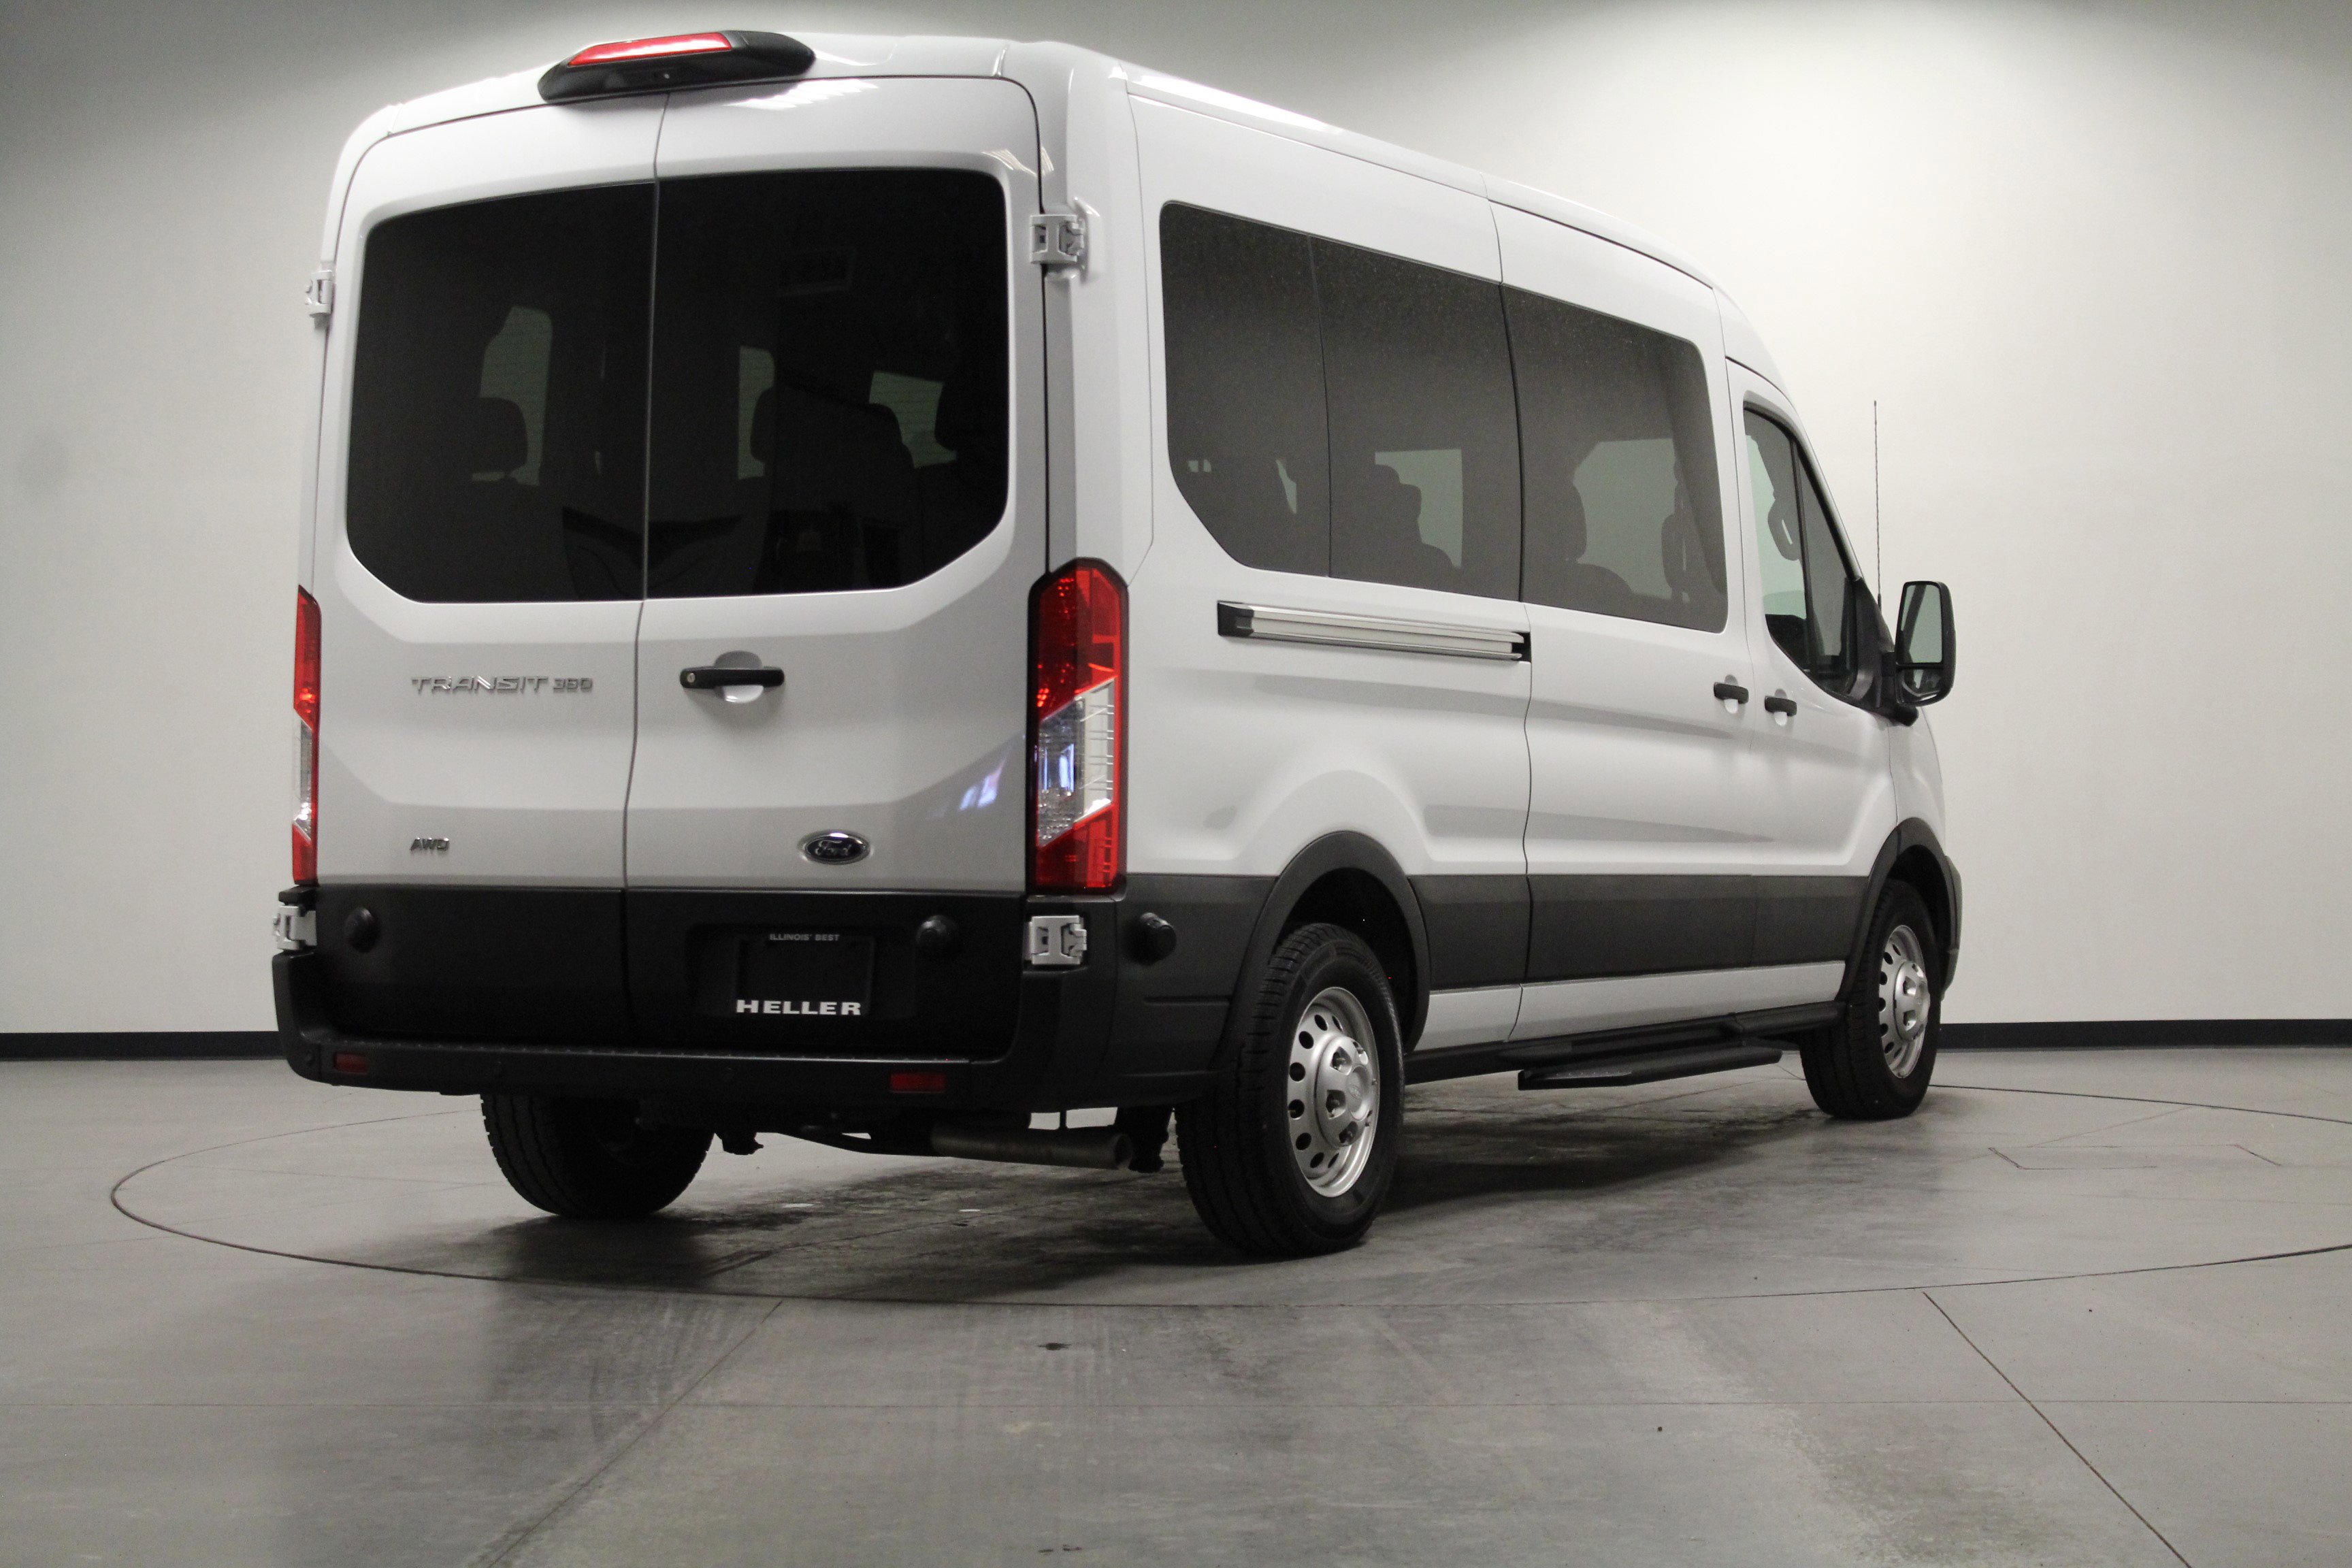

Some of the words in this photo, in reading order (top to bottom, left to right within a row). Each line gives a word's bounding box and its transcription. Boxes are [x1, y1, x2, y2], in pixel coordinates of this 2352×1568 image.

[411, 675, 549, 693] TRANSIT
[410, 837, 450, 852] AWD
[815, 934, 840, 942] BEST
[736, 999, 862, 1015] HELLER
